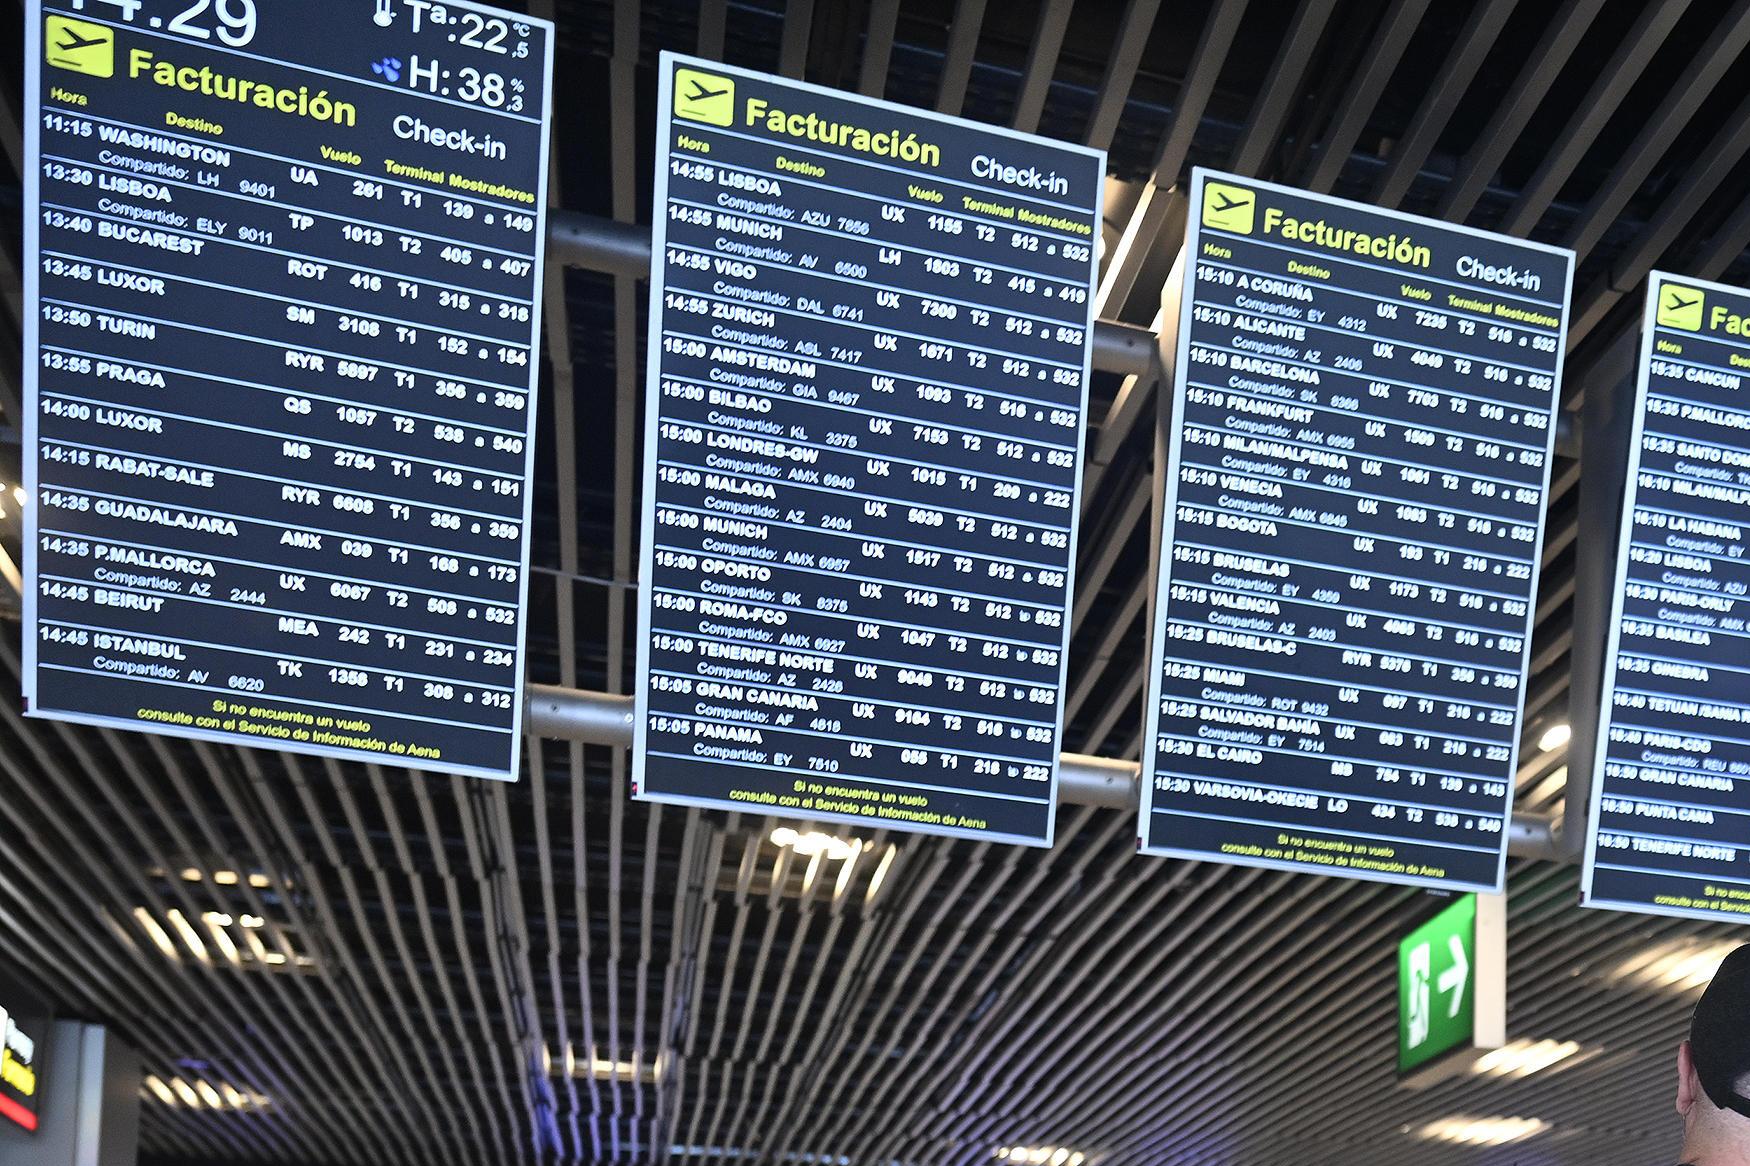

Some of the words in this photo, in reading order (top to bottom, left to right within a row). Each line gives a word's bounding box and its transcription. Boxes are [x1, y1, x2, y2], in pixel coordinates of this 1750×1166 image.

[129, 48, 356, 127] Facturación
[393, 115, 506, 161] Check-in
[50, 87, 87, 106] Hora
[166, 111, 223, 135] Destino
[320, 145, 362, 166] Vuelo
[384, 159, 445, 184] Terminal
[449, 173, 535, 204] Mostradores
[746, 98, 940, 167] Facturación
[971, 155, 1068, 196] Check-in
[43, 114, 93, 137] 11:15
[98, 125, 230, 167] WASHINGTON
[290, 166, 319, 187] UA
[352, 180, 383, 200] 261
[400, 189, 422, 208] T1
[443, 200, 474, 220] 139
[503, 213, 533, 232] 149
[98, 150, 189, 181] Compartido:
[197, 170, 219, 187] LH
[239, 179, 275, 199] 9401
[718, 169, 782, 197] LISBOA
[776, 156, 826, 178] Destino
[908, 184, 944, 203] Vuelo
[962, 196, 1015, 219] Terminal
[43, 162, 93, 186] 13:30
[99, 173, 172, 203] LISBOA
[288, 212, 314, 231] TP
[342, 224, 383, 246] 1013
[399, 235, 422, 255] T2
[440, 246, 472, 265] 405
[500, 258, 531, 277] 407
[98, 198, 188, 228] Compartido:
[196, 217, 227, 235] ELY
[238, 226, 273, 245] 9011
[716, 214, 783, 241] MUNICH
[43, 210, 92, 233] 13:40
[98, 221, 205, 256] BUCAREST
[288, 259, 328, 281] ROT
[349, 272, 382, 292] 416
[397, 281, 418, 300] T1
[439, 291, 470, 310] 315
[498, 303, 529, 322] 318
[1263, 207, 1431, 268] Facturación
[1456, 256, 1541, 292] Check-in
[42, 258, 92, 281] 13:45
[97, 268, 165, 296] LUXOR
[714, 258, 757, 280] VIGO
[42, 305, 91, 327] 13:50
[96, 314, 155, 340] TURIN
[711, 302, 775, 328] ZURICH
[1233, 315, 1306, 342] ALICANTE
[41, 352, 91, 374] 13:55
[96, 361, 166, 389] PRAGA
[710, 346, 816, 379] AMSTERDAM
[1230, 355, 1320, 385] BARCELONA
[40, 399, 90, 421] 14:00
[96, 408, 163, 434] LUXOR
[709, 389, 772, 413] BILBAO
[1226, 395, 1314, 424] FRANKFURT
[41, 445, 90, 466] 14:15
[95, 453, 214, 488] RABAT-SALE
[705, 474, 776, 500] MALAGA
[1220, 474, 1283, 498] VENECIA
[40, 490, 90, 512] 14:35
[95, 500, 238, 537] GUADALAJARA
[1216, 513, 1278, 537] BOGOTA
[40, 536, 89, 557] 14:35
[94, 544, 216, 578] P.MALLORCA
[701, 558, 771, 582] OPORTO
[40, 581, 89, 602] 14:45
[94, 589, 165, 613] BEIRUT
[39, 626, 88, 646] 14:45
[94, 633, 186, 661] ISTANBUL
[137, 708, 194, 725] consulte
[195, 716, 220, 728] con
[222, 719, 236, 731] el
[238, 720, 291, 738] Servicio
[292, 728, 310, 741] de
[312, 730, 386, 752] Información
[388, 741, 406, 754] de
[406, 743, 441, 759] Aena
[212, 699, 227, 713] Si
[229, 704, 247, 716] no
[249, 707, 314, 725] encuentra
[316, 716, 333, 728] un
[335, 719, 371, 733] vuelo
[694, 722, 763, 744] PANAMA
